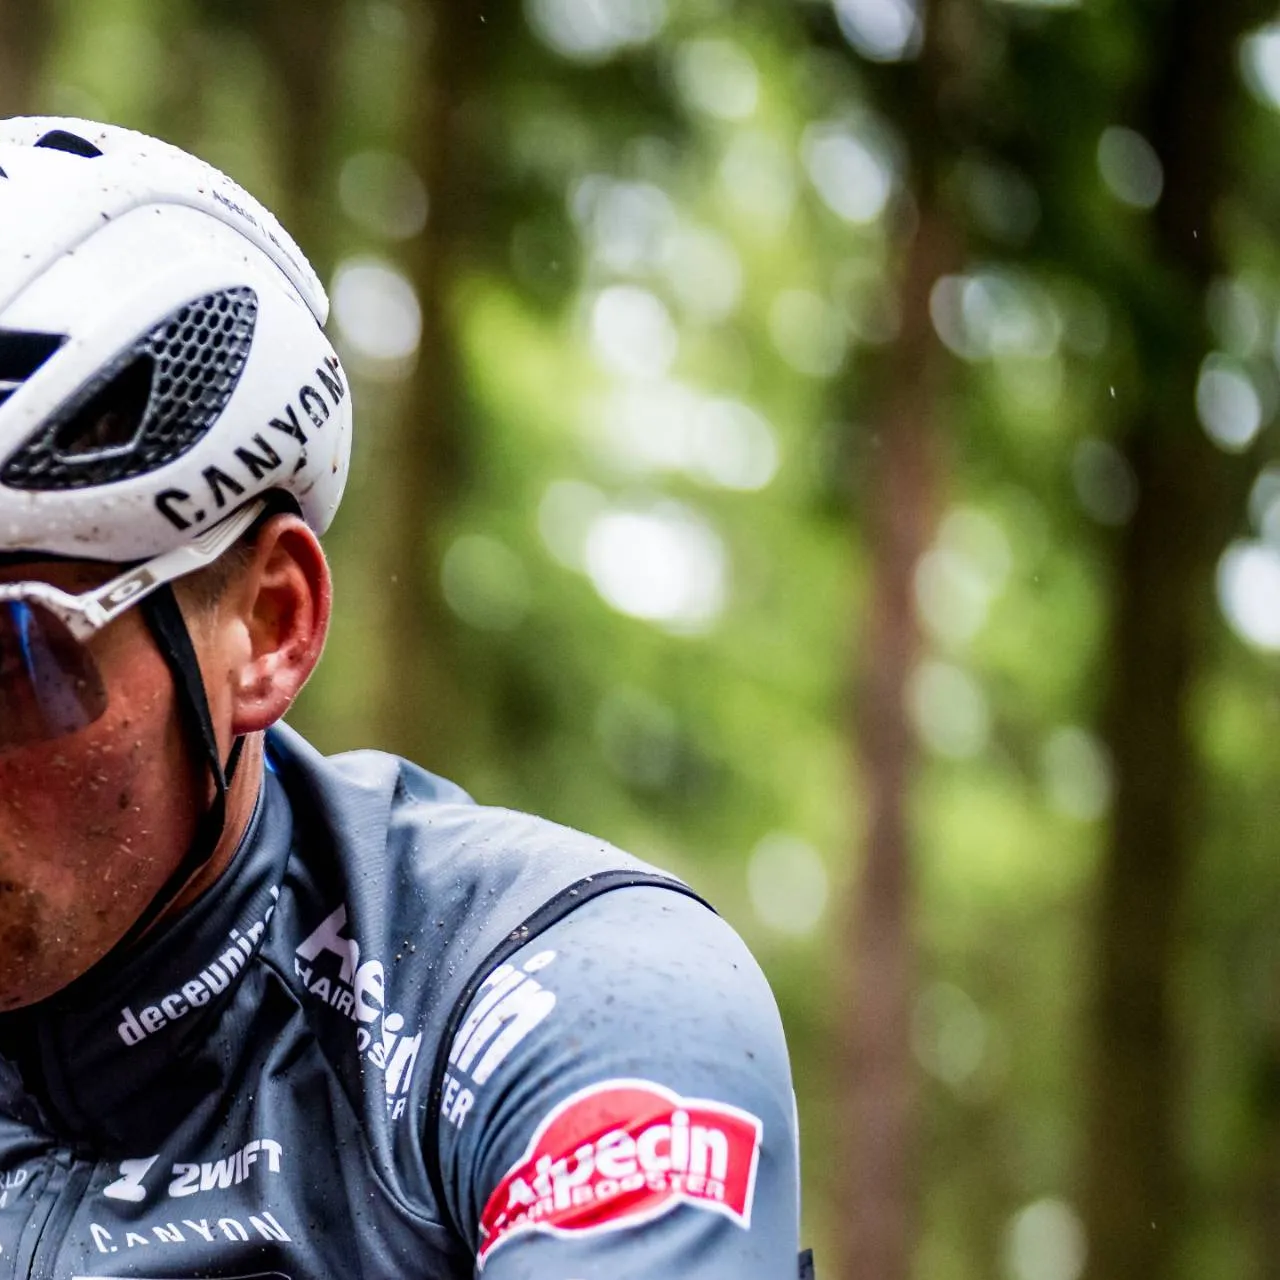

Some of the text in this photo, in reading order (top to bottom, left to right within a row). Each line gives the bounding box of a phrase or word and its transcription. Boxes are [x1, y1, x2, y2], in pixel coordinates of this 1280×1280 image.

[154, 356, 345, 531] CANYON
[167, 1138, 284, 1199] ZWIFT
[506, 1109, 730, 1211] Alpecin
[89, 1211, 293, 1253] CANYON
